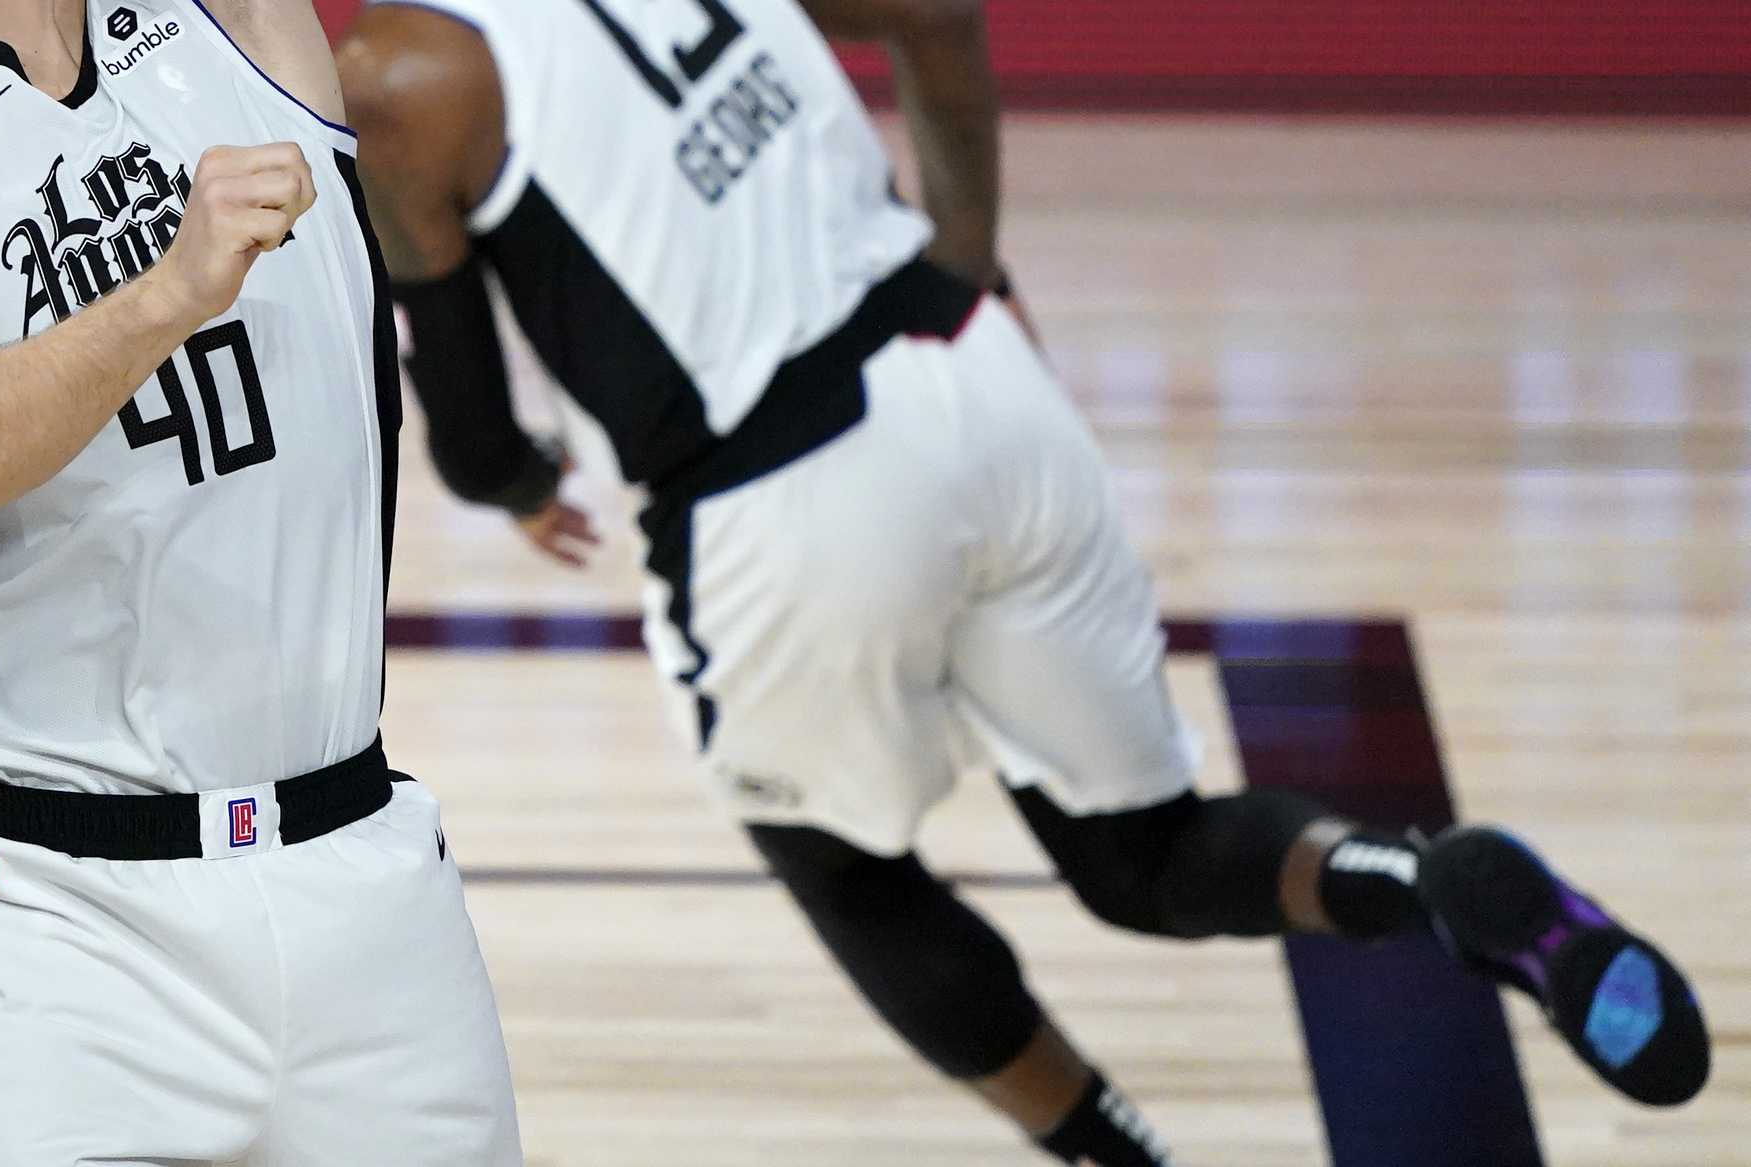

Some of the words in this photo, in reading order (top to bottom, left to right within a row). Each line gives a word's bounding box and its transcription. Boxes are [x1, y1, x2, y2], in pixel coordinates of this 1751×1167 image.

[101, 20, 181, 76] bumble
[35, 141, 175, 254] Los
[118, 319, 277, 487] 40
